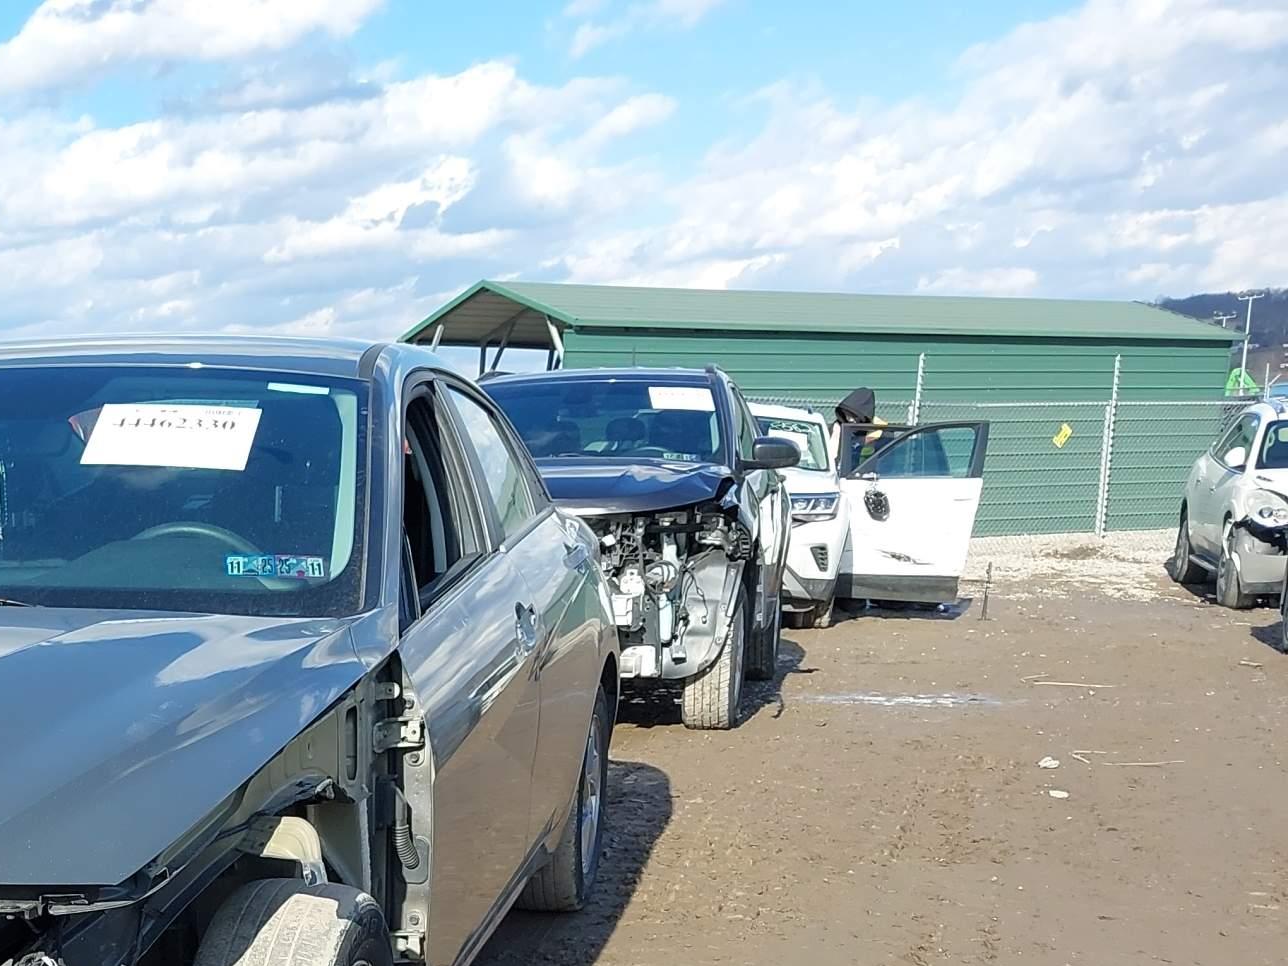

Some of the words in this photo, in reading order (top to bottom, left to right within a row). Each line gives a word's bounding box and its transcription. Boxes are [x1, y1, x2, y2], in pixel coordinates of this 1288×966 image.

[229, 560, 241, 574] 11
[261, 558, 273, 573] 25
[279, 558, 291, 574] 25
[310, 562, 322, 576] 11
